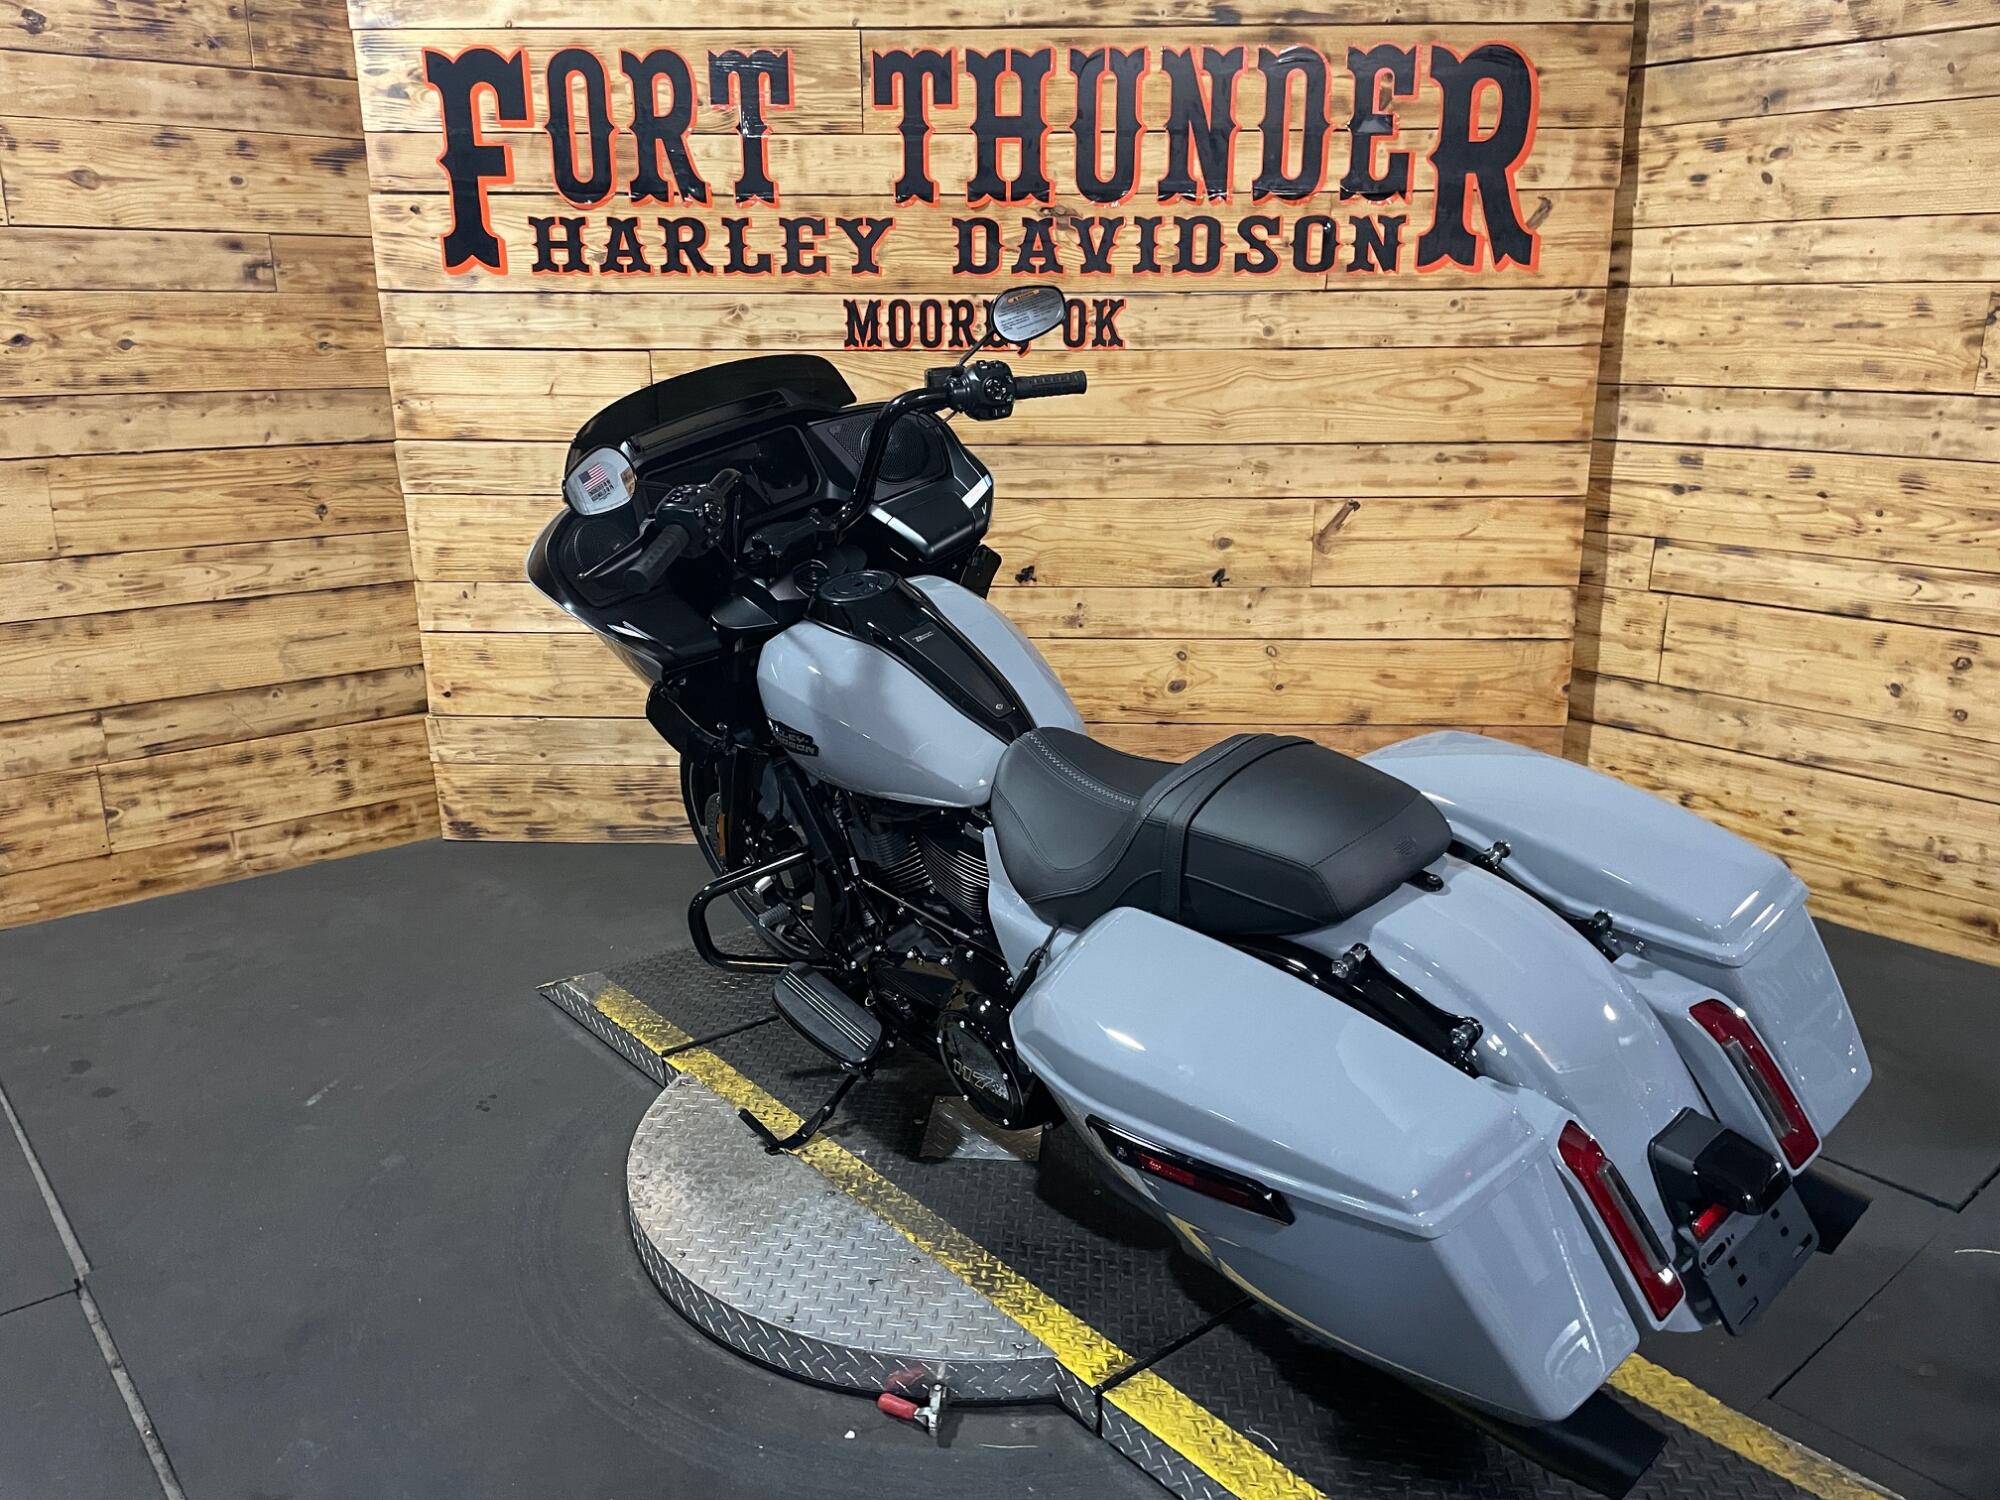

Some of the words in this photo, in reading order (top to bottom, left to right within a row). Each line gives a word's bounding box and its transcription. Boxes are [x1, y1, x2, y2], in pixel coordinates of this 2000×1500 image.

[421, 44, 795, 276] FORT
[872, 42, 1541, 275] THUNDER
[527, 215, 897, 277] HARLEY
[952, 213, 1408, 277] DAVIDSON
[1062, 297, 1128, 352] OK
